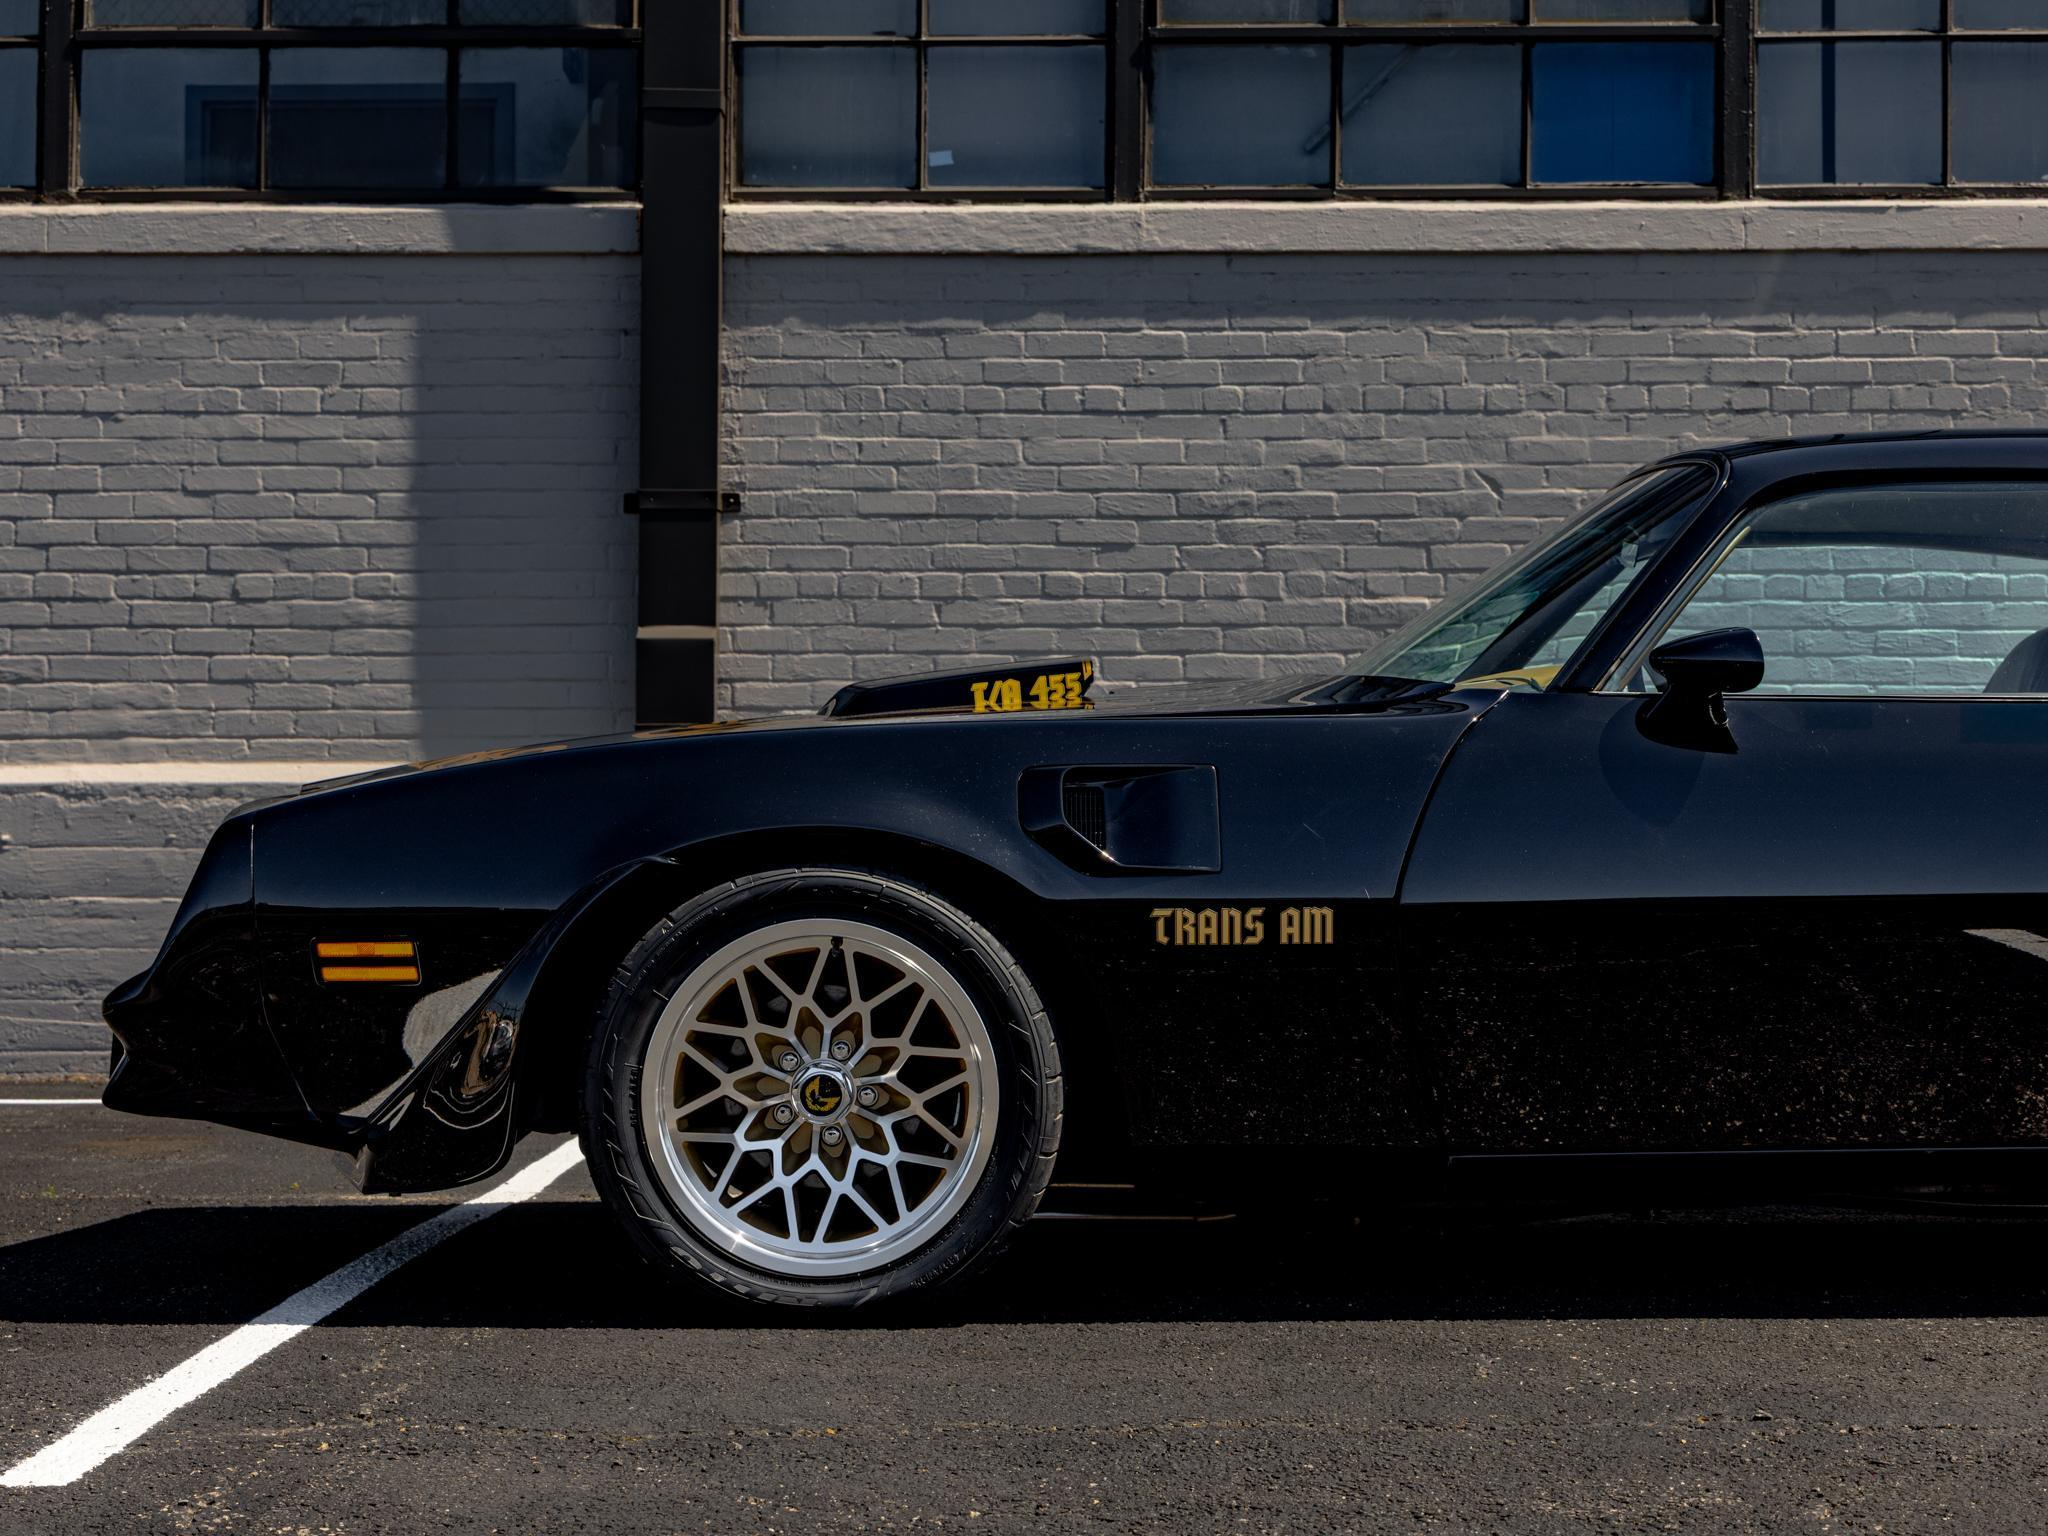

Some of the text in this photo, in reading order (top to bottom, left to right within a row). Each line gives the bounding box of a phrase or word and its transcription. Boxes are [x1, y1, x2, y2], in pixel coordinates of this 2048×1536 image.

[1029, 672, 1083, 707] 455
[1150, 906, 1334, 946] TRANS AM
